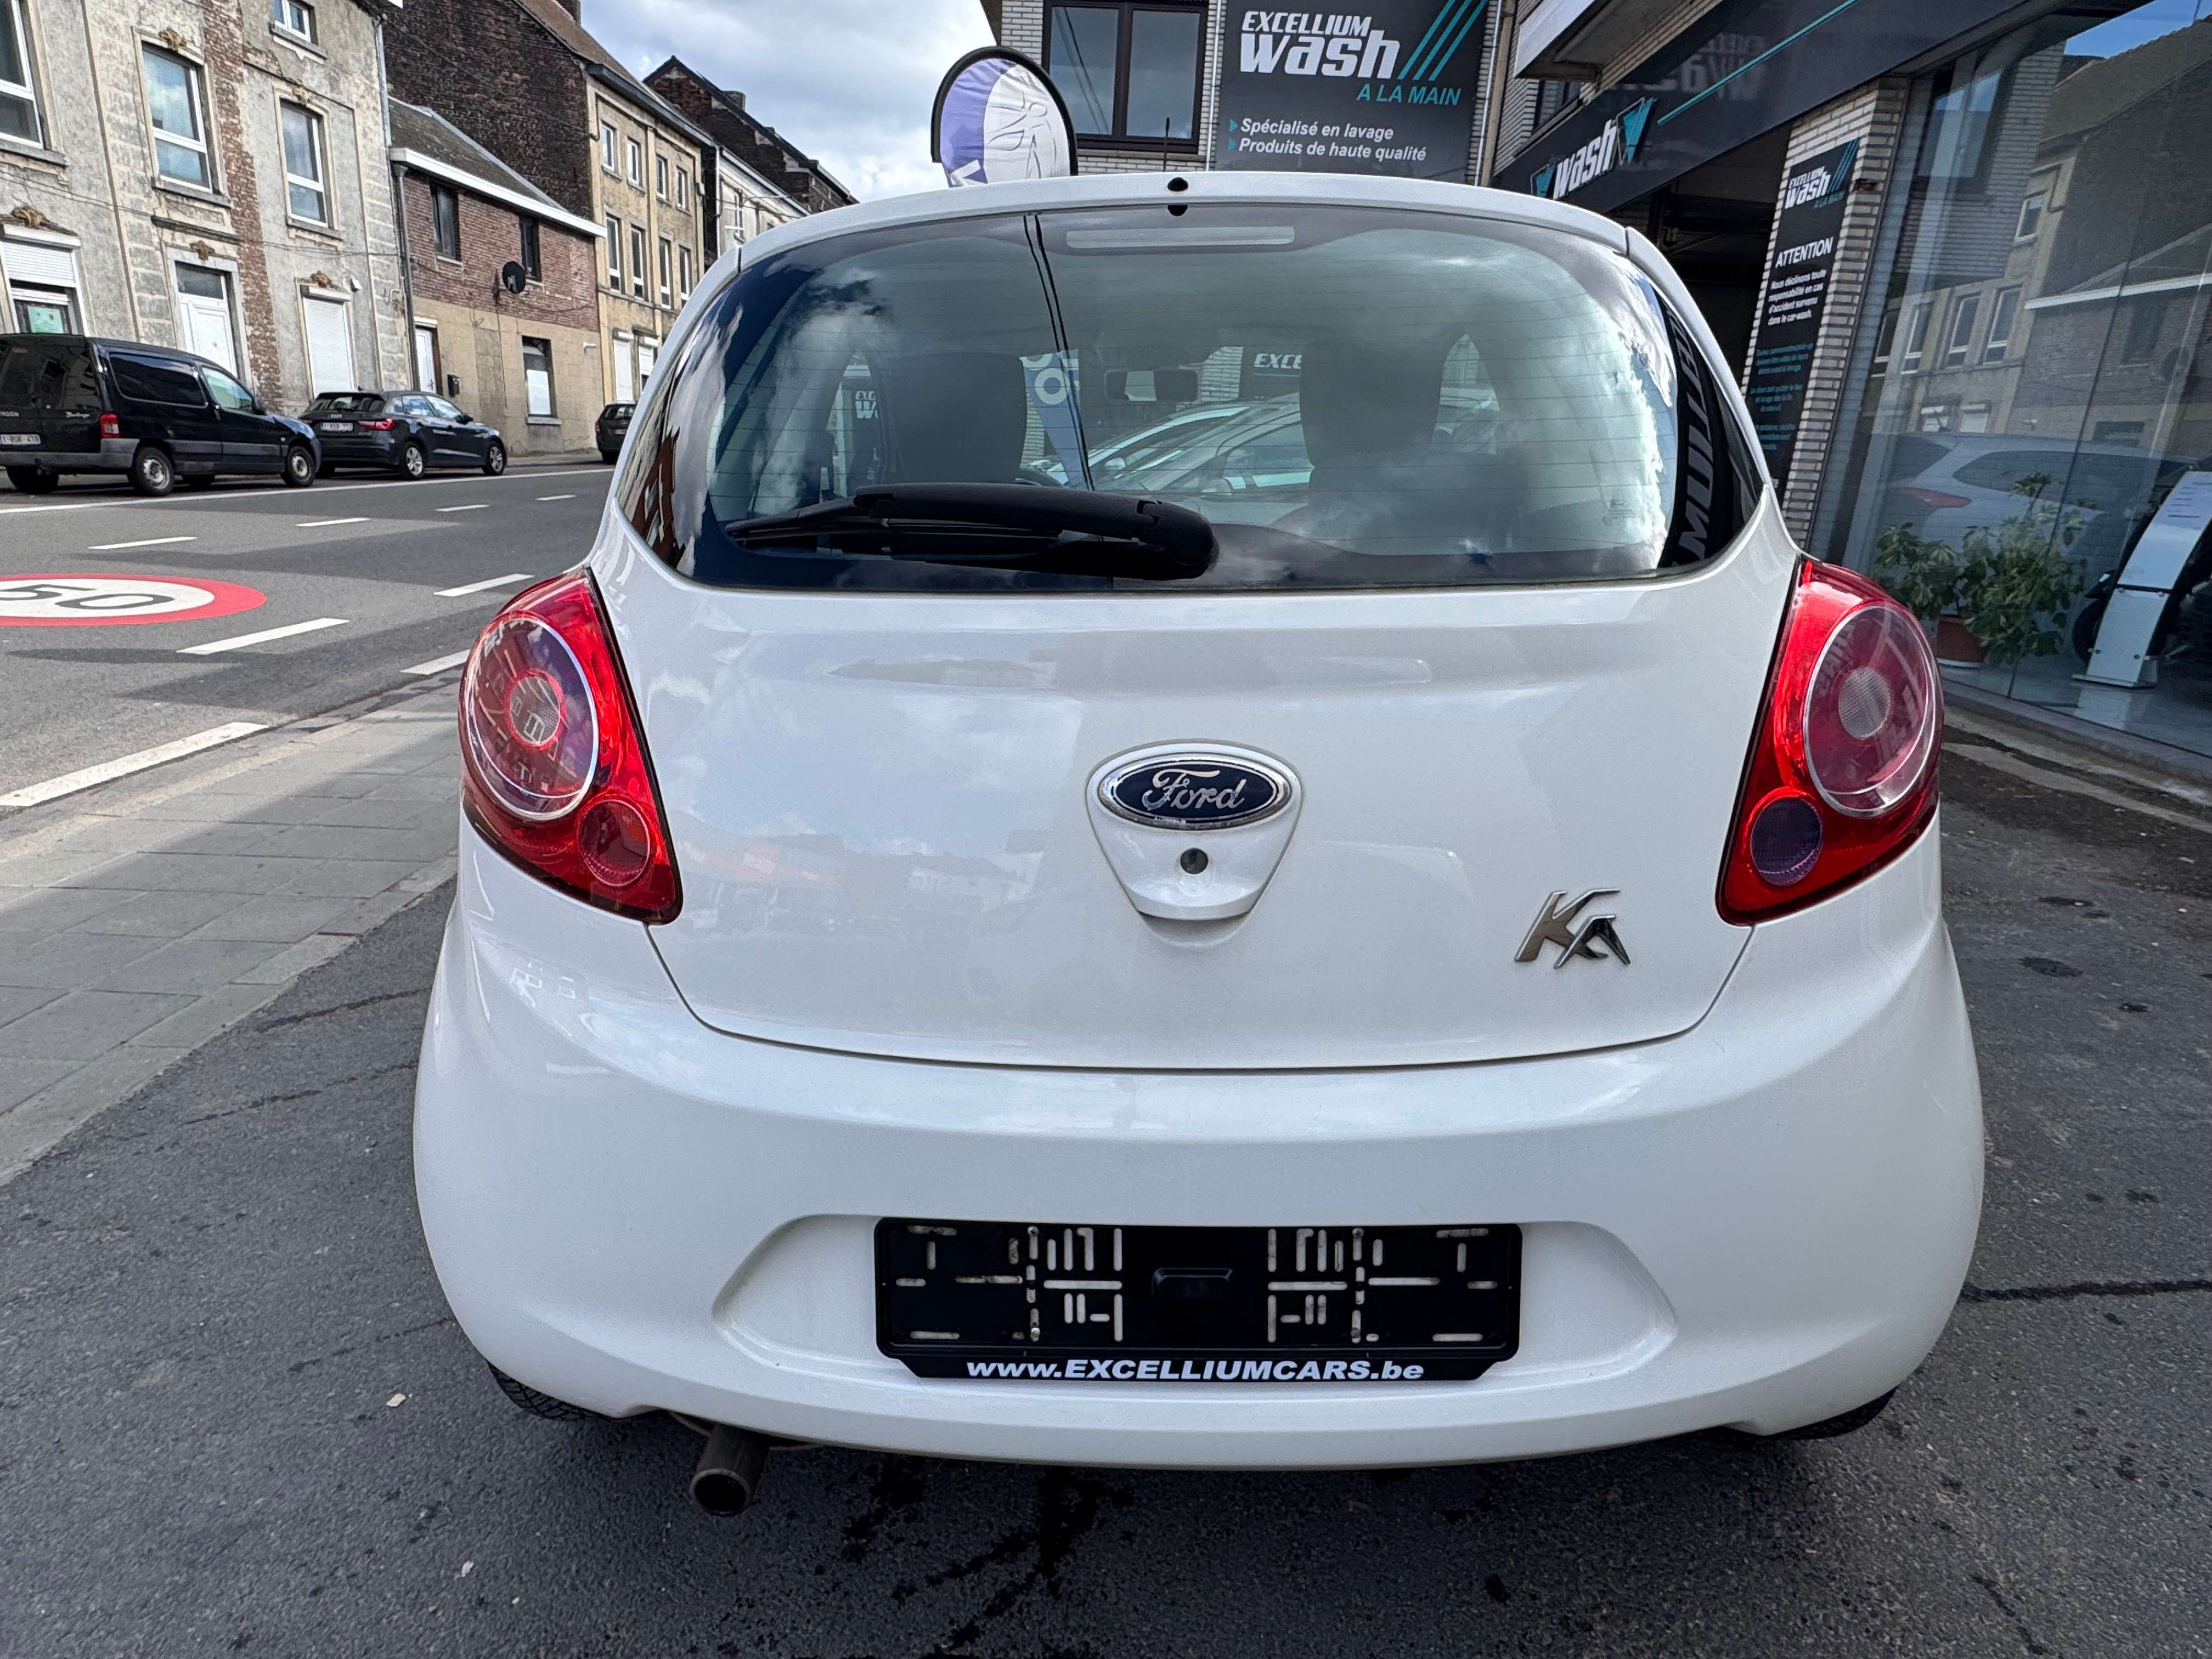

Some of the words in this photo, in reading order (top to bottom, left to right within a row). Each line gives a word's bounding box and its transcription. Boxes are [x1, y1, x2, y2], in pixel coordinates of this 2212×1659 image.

[1241, 11, 1372, 37] EXCELLIUM
[1357, 83, 1371, 101] A
[1376, 84, 1403, 103] LA
[1408, 86, 1462, 106] MAIN
[1240, 117, 1318, 136] Spécialisé
[1321, 125, 1340, 137] en
[1344, 123, 1394, 143] lavage
[1239, 137, 1303, 155] Produits
[1307, 140, 1325, 156] de
[1329, 142, 1372, 158] haute
[1375, 146, 1426, 162] qualité
[1775, 236, 1833, 269] ATTENTION
[0, 584, 176, 610] 50
[1141, 769, 1247, 811] Ford
[967, 1359, 1425, 1380] www.EXCELLIUMCARS.be
